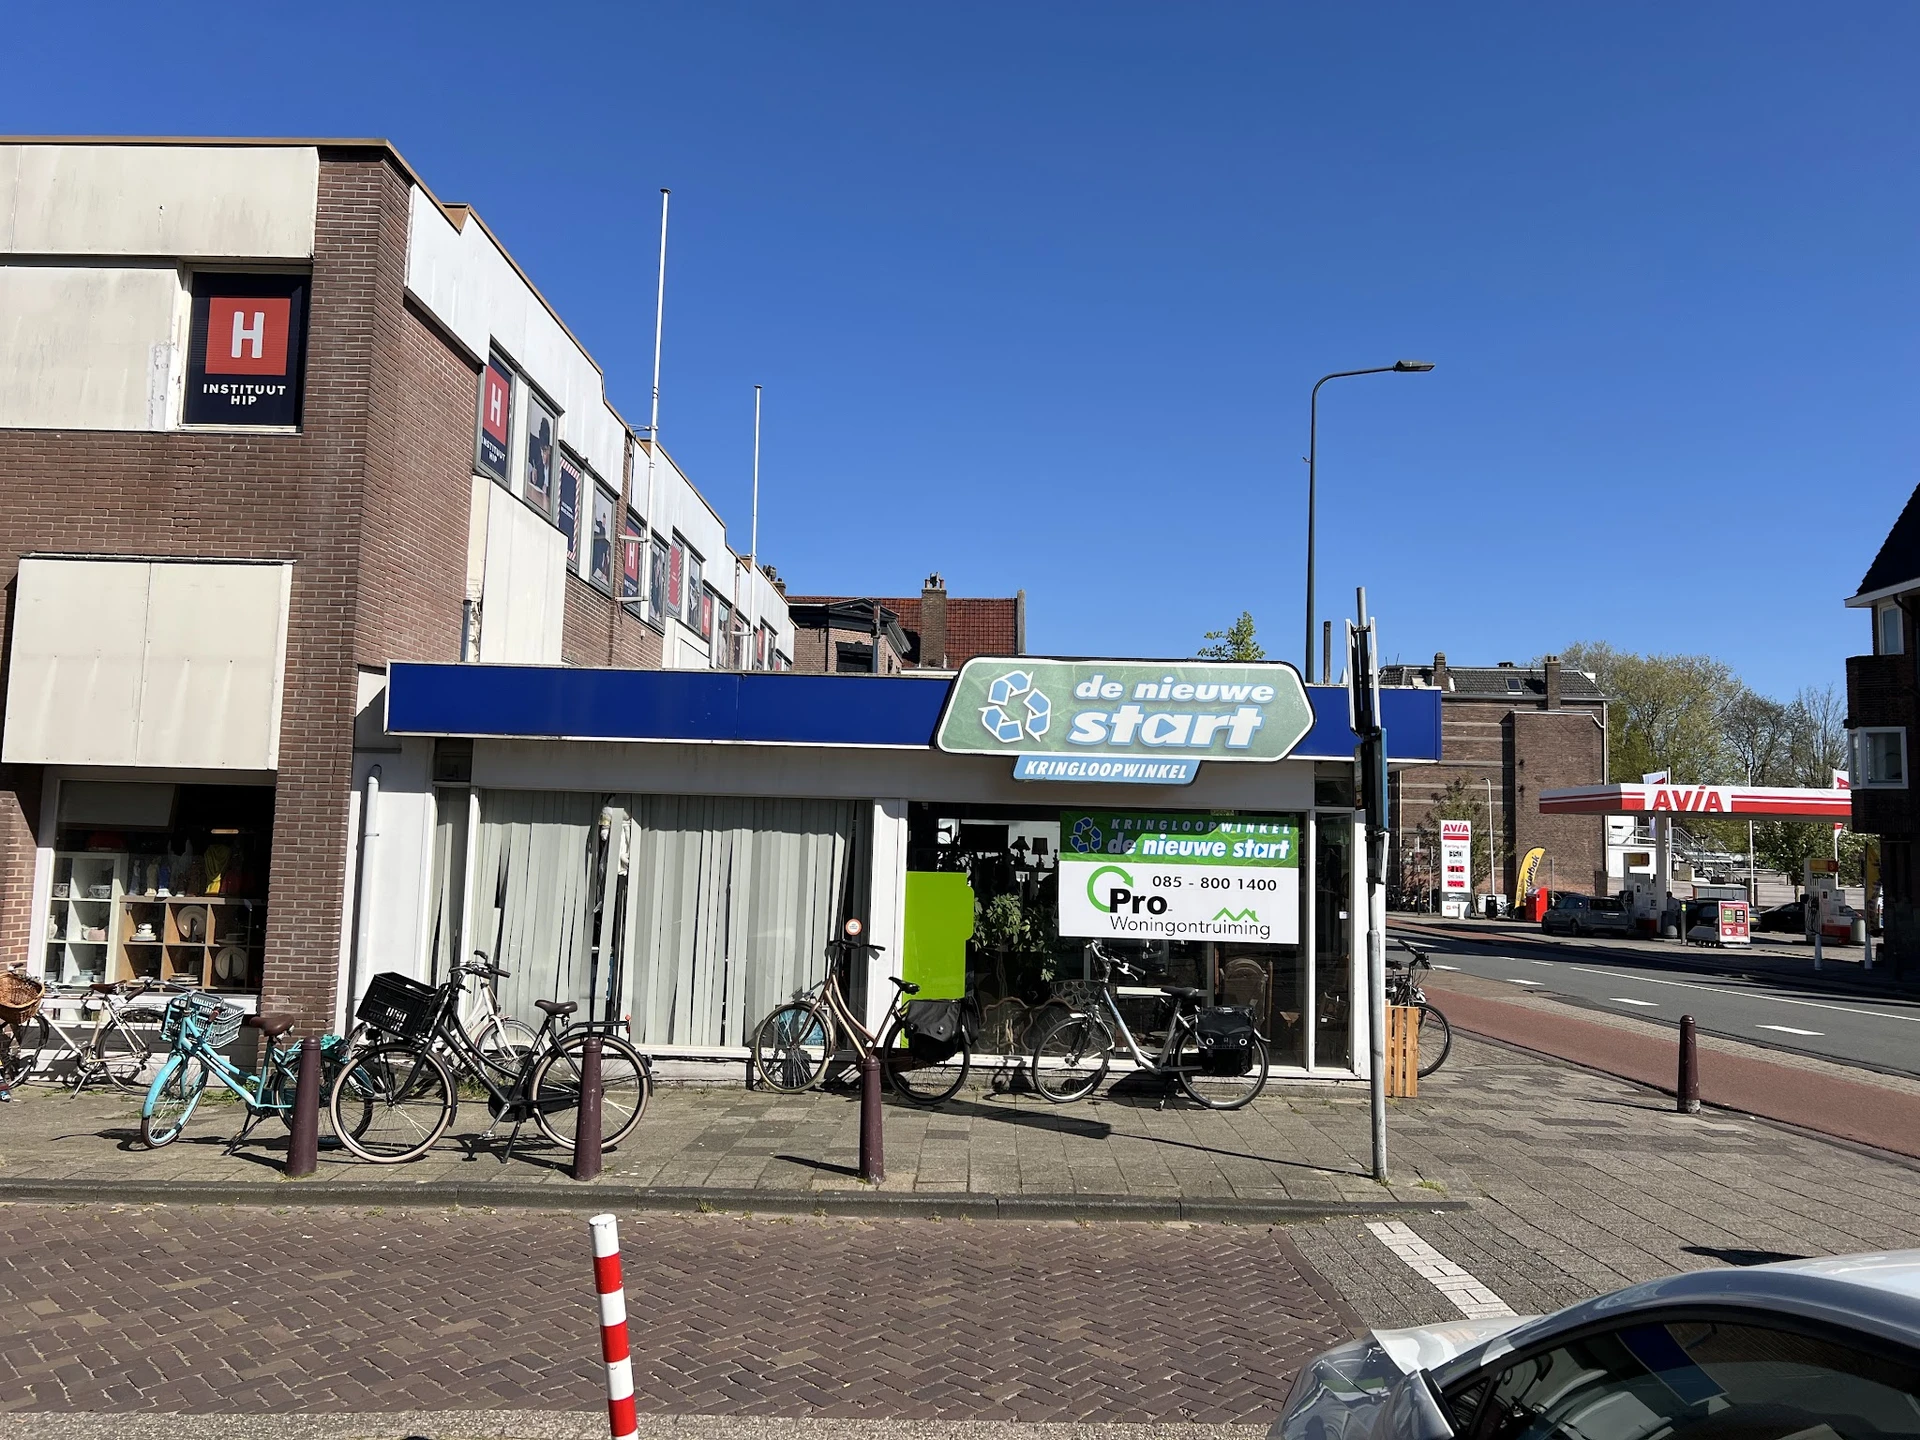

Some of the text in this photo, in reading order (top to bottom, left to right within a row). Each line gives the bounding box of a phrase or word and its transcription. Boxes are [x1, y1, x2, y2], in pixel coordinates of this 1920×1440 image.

[231, 311, 265, 359] H
[202, 383, 286, 396] INSTITUUT
[230, 395, 258, 405] HIP
[490, 382, 502, 427] H
[628, 542, 635, 570] H
[1075, 673, 1276, 703] de nieuwe
[1067, 703, 1266, 750] start
[1023, 760, 1188, 780] KRINGLOOPWINKEL
[1111, 818, 1291, 835] KRINGLOOPWINKEL
[1107, 832, 1290, 860] de nieuwe start
[1152, 875, 1182, 888] 085
[1200, 877, 1231, 890] 800
[1237, 878, 1277, 892] 1400
[1110, 915, 1271, 940] Woningontruiming
